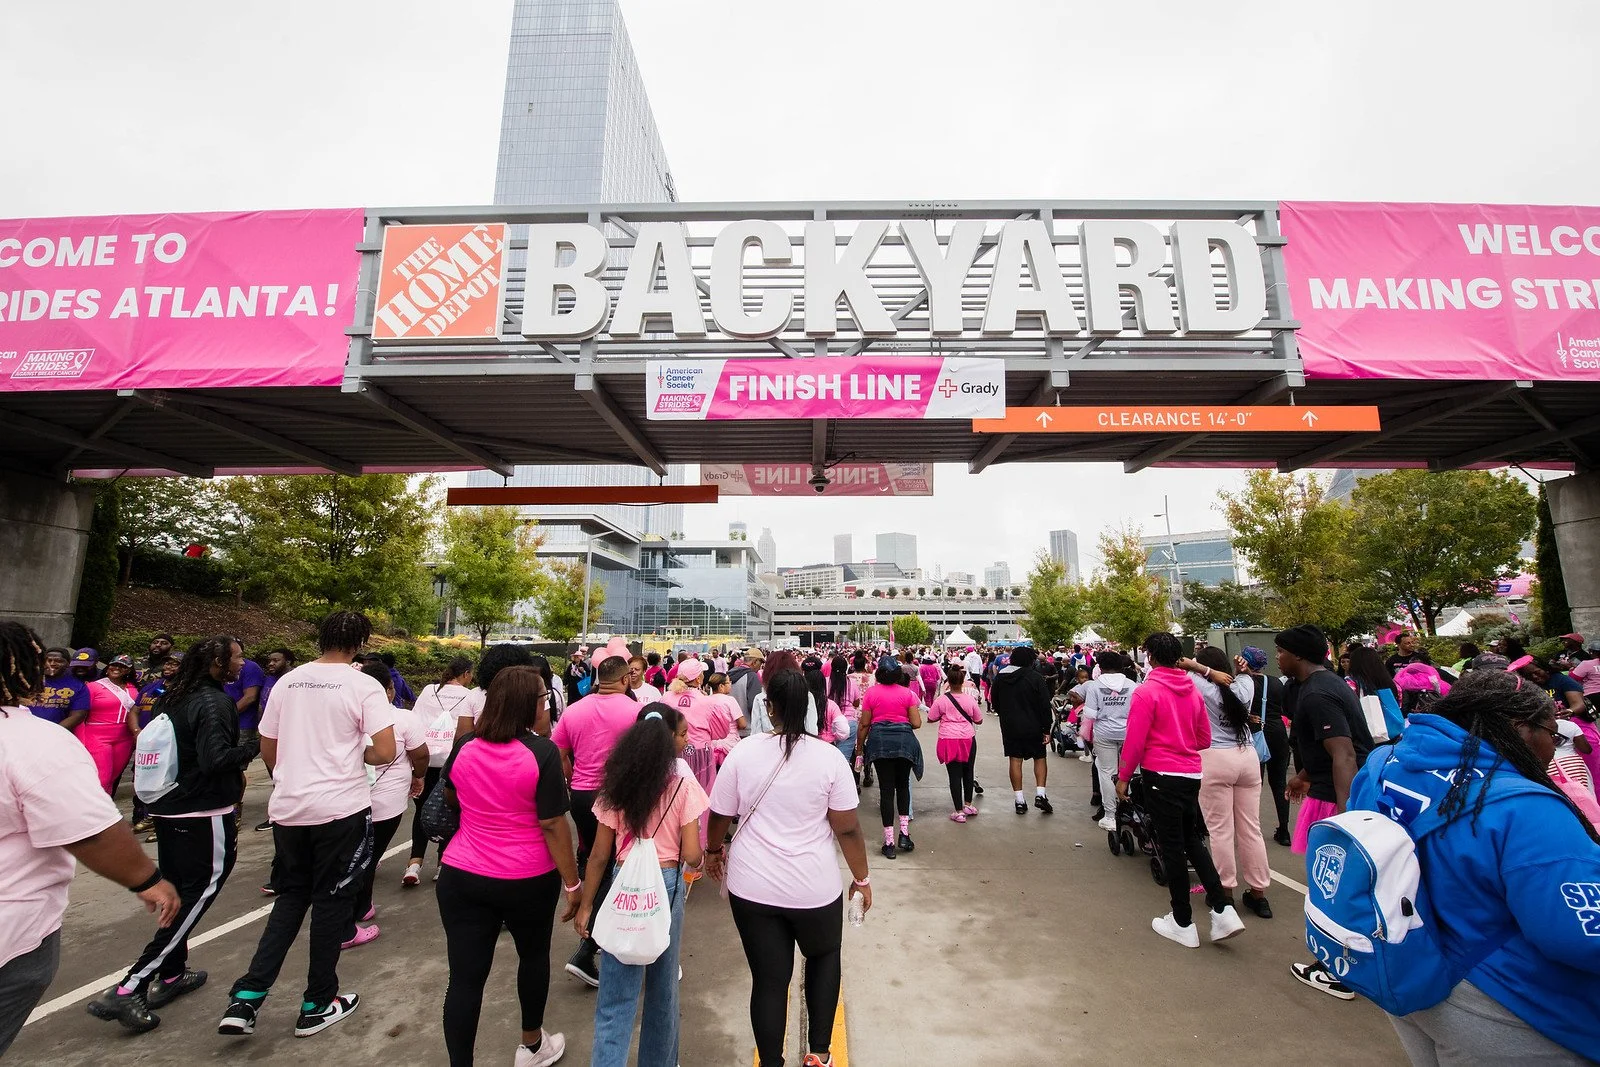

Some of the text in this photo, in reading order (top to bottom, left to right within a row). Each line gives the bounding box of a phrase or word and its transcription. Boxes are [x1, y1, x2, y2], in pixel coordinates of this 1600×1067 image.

[131, 233, 187, 264] TO
[392, 236, 445, 281] THE
[376, 224, 503, 338] HOME
[521, 220, 1267, 340] BACKYARD
[1308, 277, 1503, 310] MAKING
[109, 283, 339, 320] ATLANTA!
[422, 264, 500, 337] DEPOT
[21, 361, 70, 371] STRIDES
[28, 352, 75, 362] MAKING
[666, 381, 696, 389] Society
[729, 374, 921, 400] FINISH LINE
[960, 382, 999, 397] Grady
[1097, 412, 1202, 426] CLEARANCE
